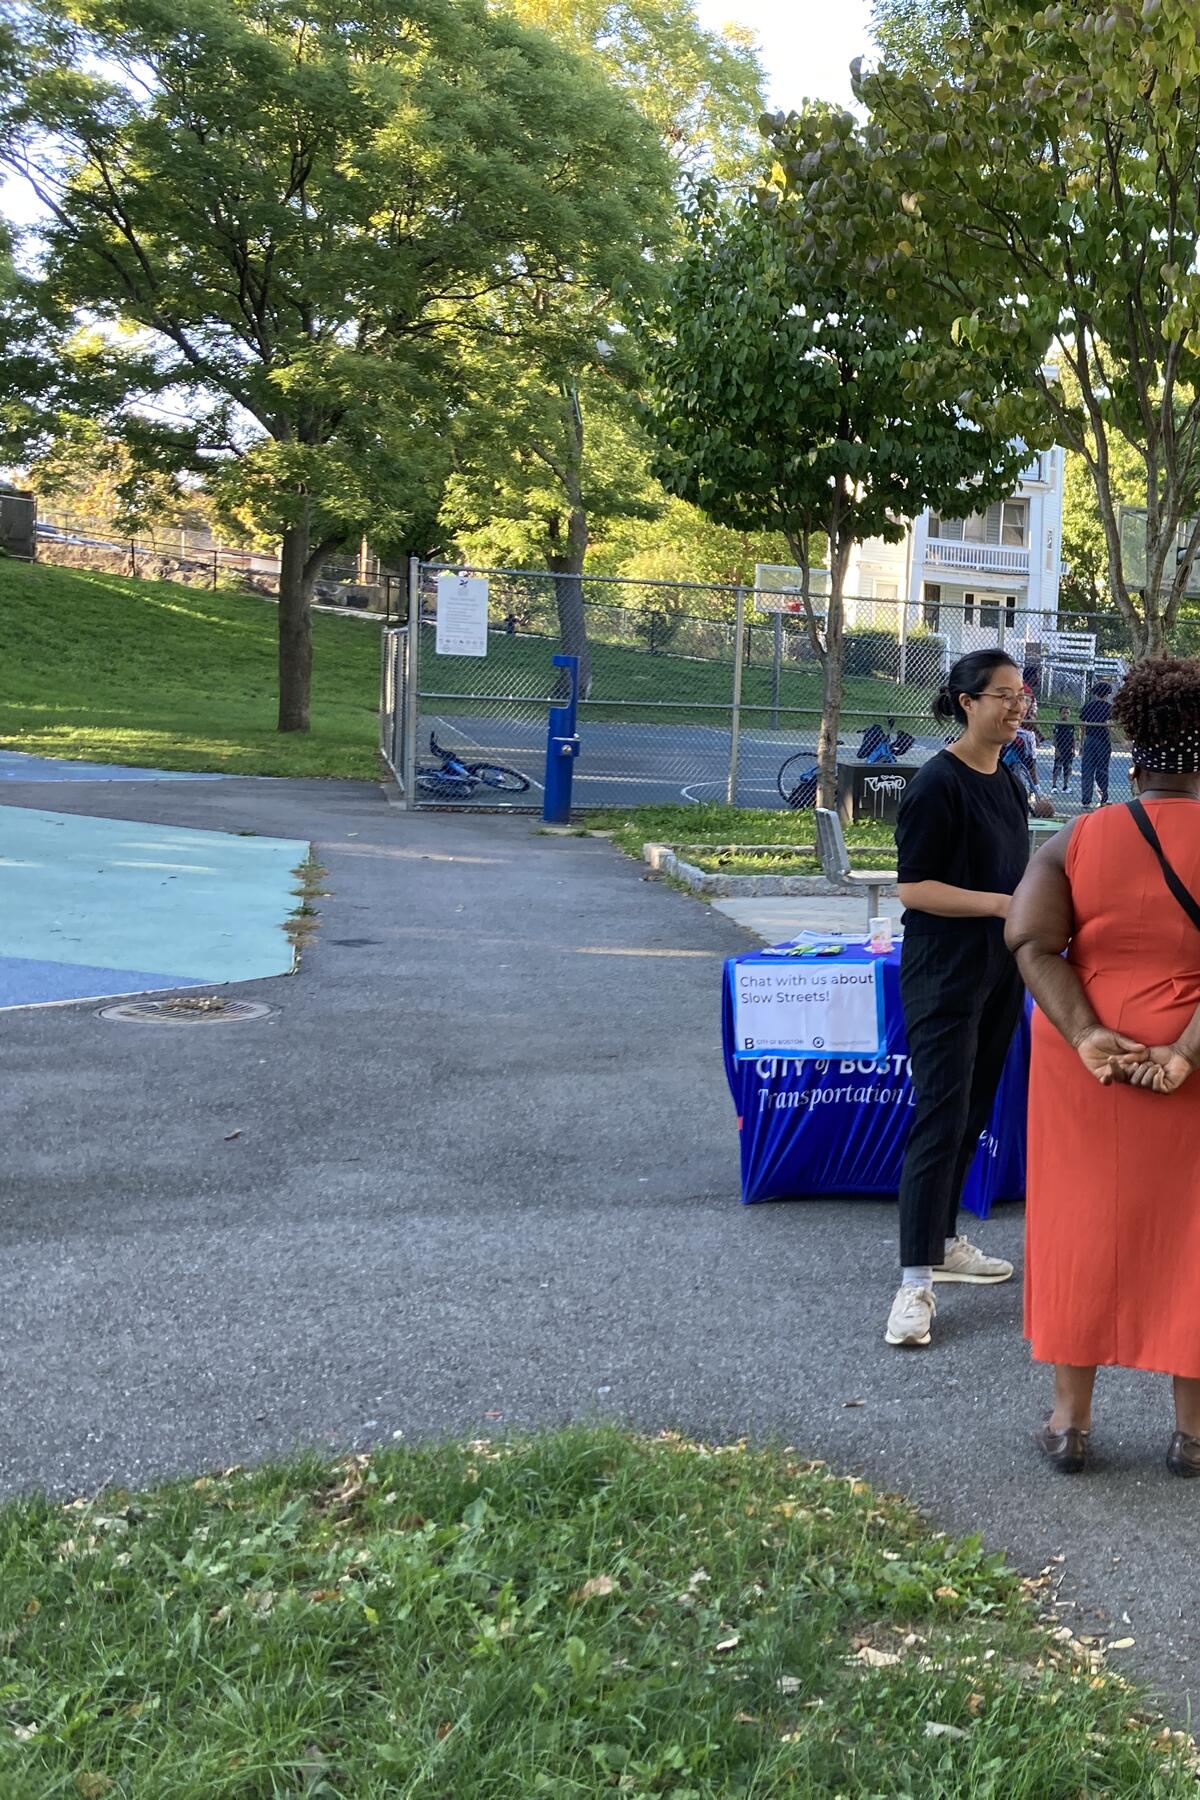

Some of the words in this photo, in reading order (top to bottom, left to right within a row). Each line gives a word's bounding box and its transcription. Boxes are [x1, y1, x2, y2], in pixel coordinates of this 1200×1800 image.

[740, 976, 772, 988] Chat
[776, 974, 807, 986] with
[811, 976, 828, 985] us
[831, 973, 874, 985] about
[741, 993, 772, 1004] Slow
[776, 990, 830, 1003] Streets!
[756, 1057, 805, 1080] CITY
[758, 1083, 902, 1112] Transportation
